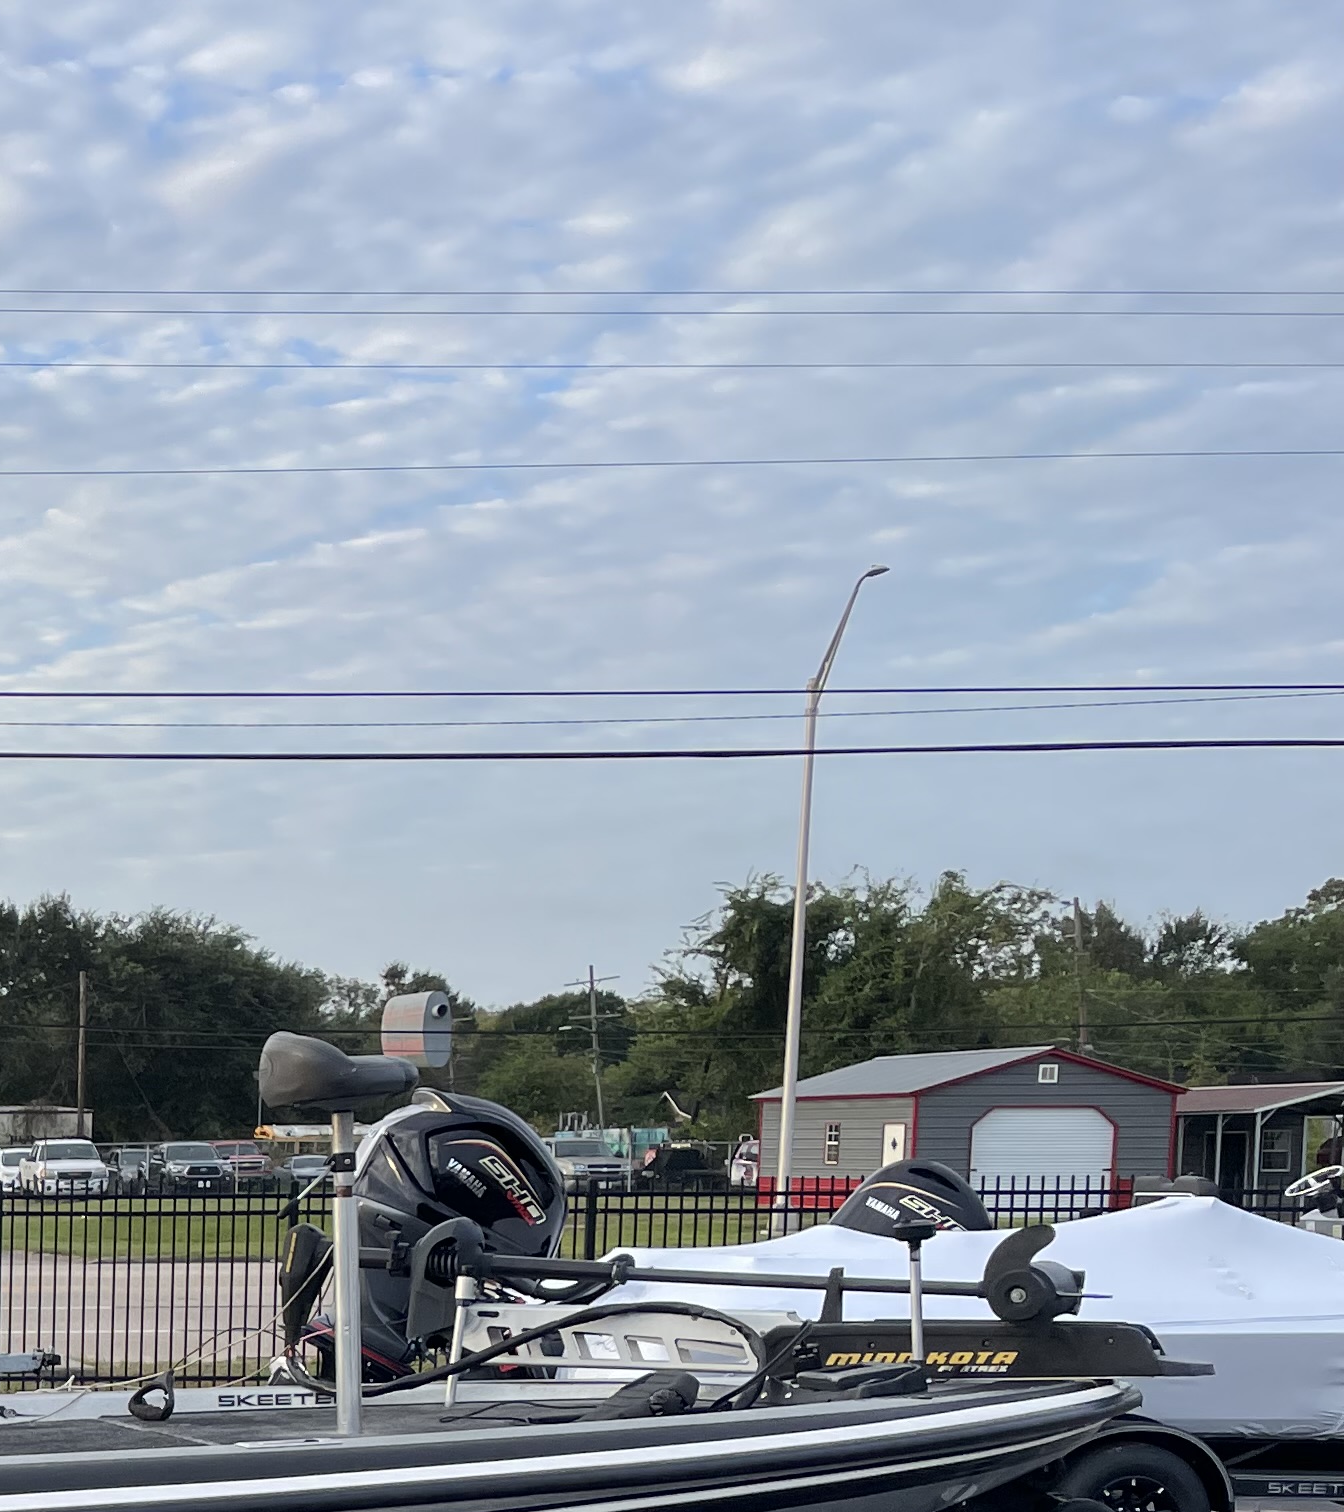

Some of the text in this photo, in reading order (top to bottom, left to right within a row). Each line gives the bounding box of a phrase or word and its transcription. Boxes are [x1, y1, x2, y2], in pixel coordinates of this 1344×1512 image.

[445, 1155, 547, 1225] YAMAHA SHO
[865, 1196, 901, 1221] YAMAHA
[925, 1351, 1019, 1365] KOTA
[217, 1392, 337, 1408] SKEETE
[1267, 1481, 1344, 1495] SKEET
